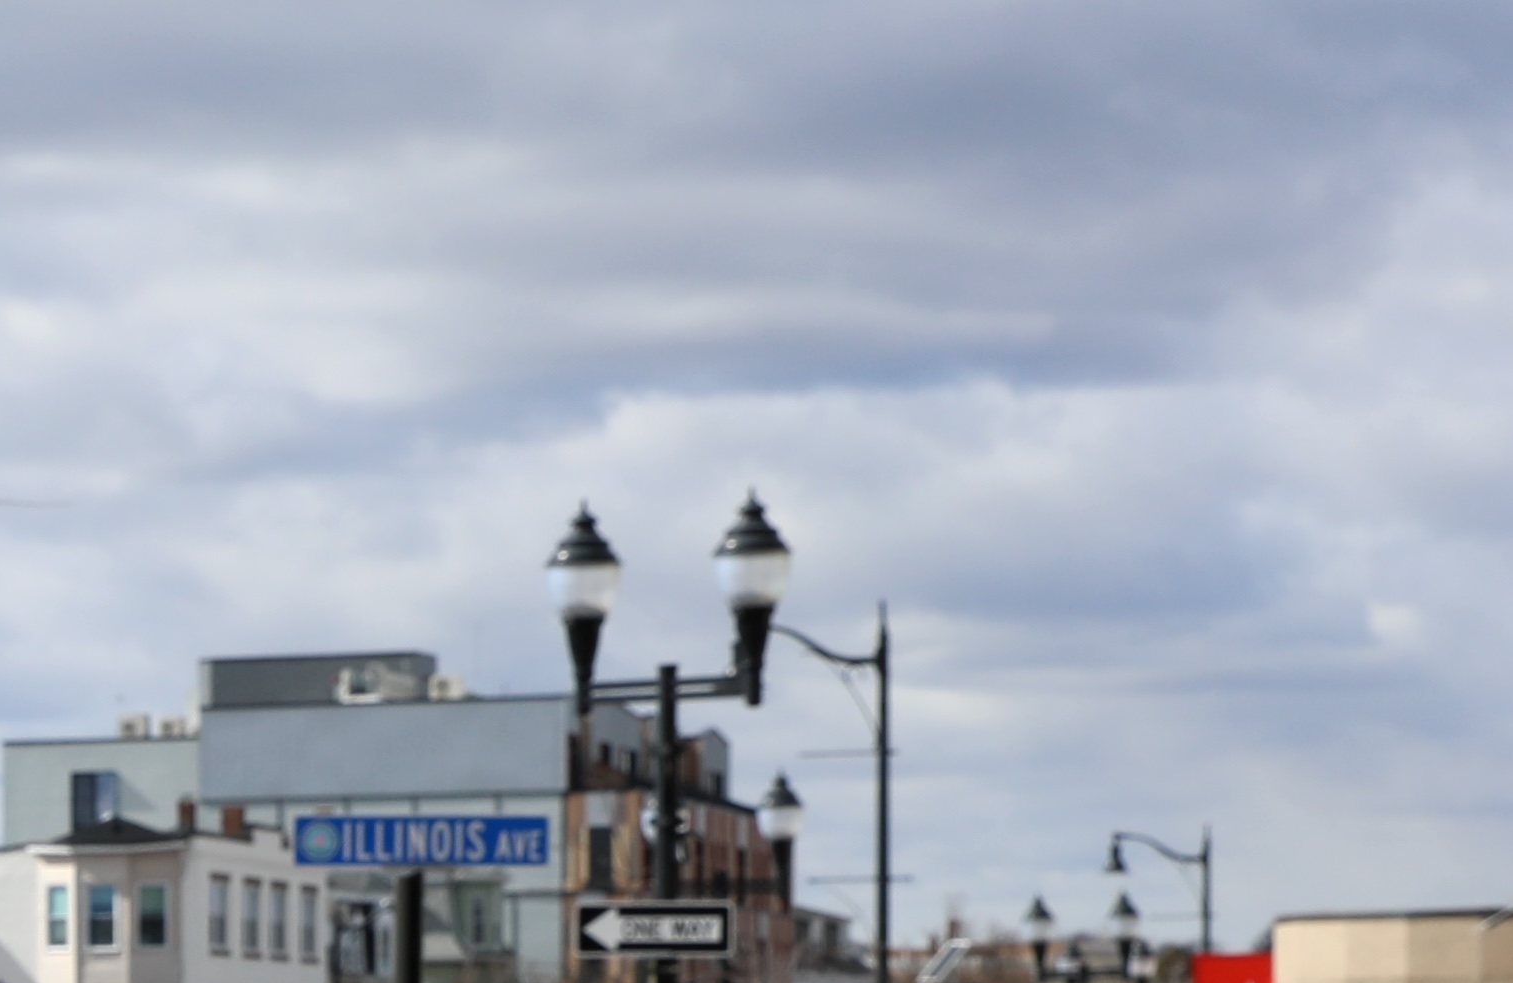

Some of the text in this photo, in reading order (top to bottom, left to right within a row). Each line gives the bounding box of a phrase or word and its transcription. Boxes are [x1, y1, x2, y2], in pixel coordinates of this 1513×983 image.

[341, 819, 544, 862] ILLINOIS AVE
[622, 918, 715, 938] ONE WAY
